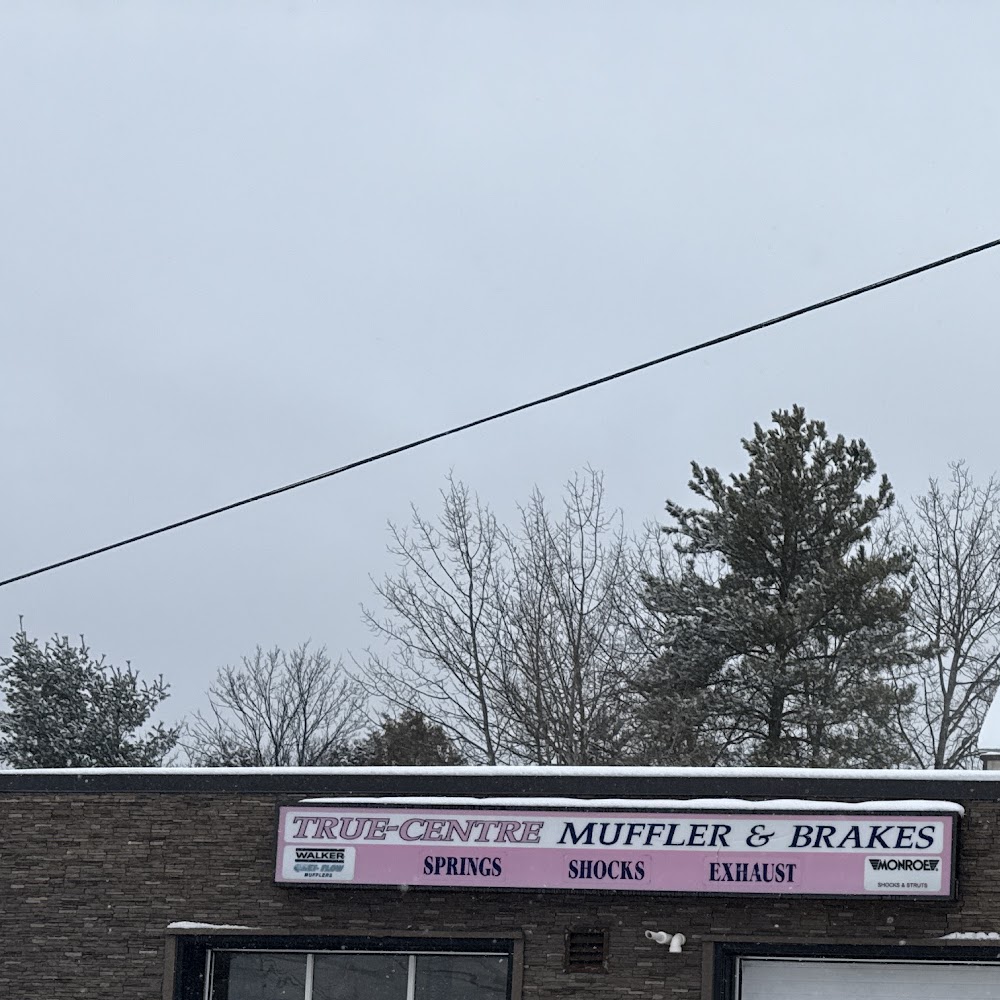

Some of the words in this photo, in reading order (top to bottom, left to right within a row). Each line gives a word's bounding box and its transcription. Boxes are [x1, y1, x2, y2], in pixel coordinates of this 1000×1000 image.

[292, 816, 544, 844] TRUE-CENTRE
[557, 821, 732, 847] MUFFLER
[746, 824, 775, 847] &
[788, 824, 936, 850] BRAKES
[424, 855, 503, 877] SPRINGS
[568, 859, 645, 881] SHOCKS
[709, 862, 797, 883] EXHAUST
[878, 859, 931, 871] MONROE
